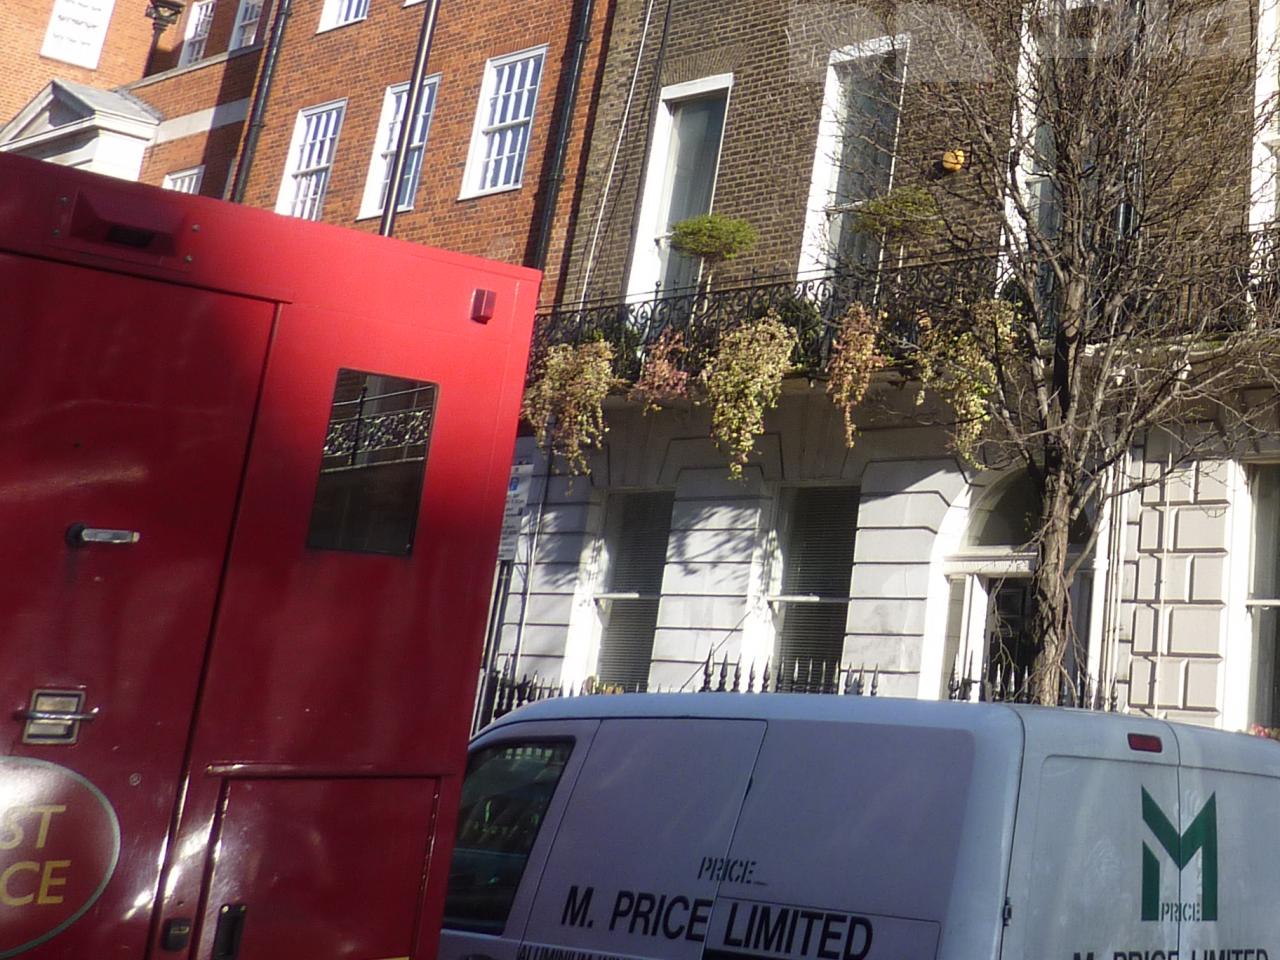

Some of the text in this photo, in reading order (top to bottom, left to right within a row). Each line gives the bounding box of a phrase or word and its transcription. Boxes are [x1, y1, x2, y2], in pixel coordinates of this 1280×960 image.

[697, 855, 758, 885] PRICE
[560, 885, 874, 960] M. PRICE LIMITED
[1160, 902, 1202, 922] PRICE
